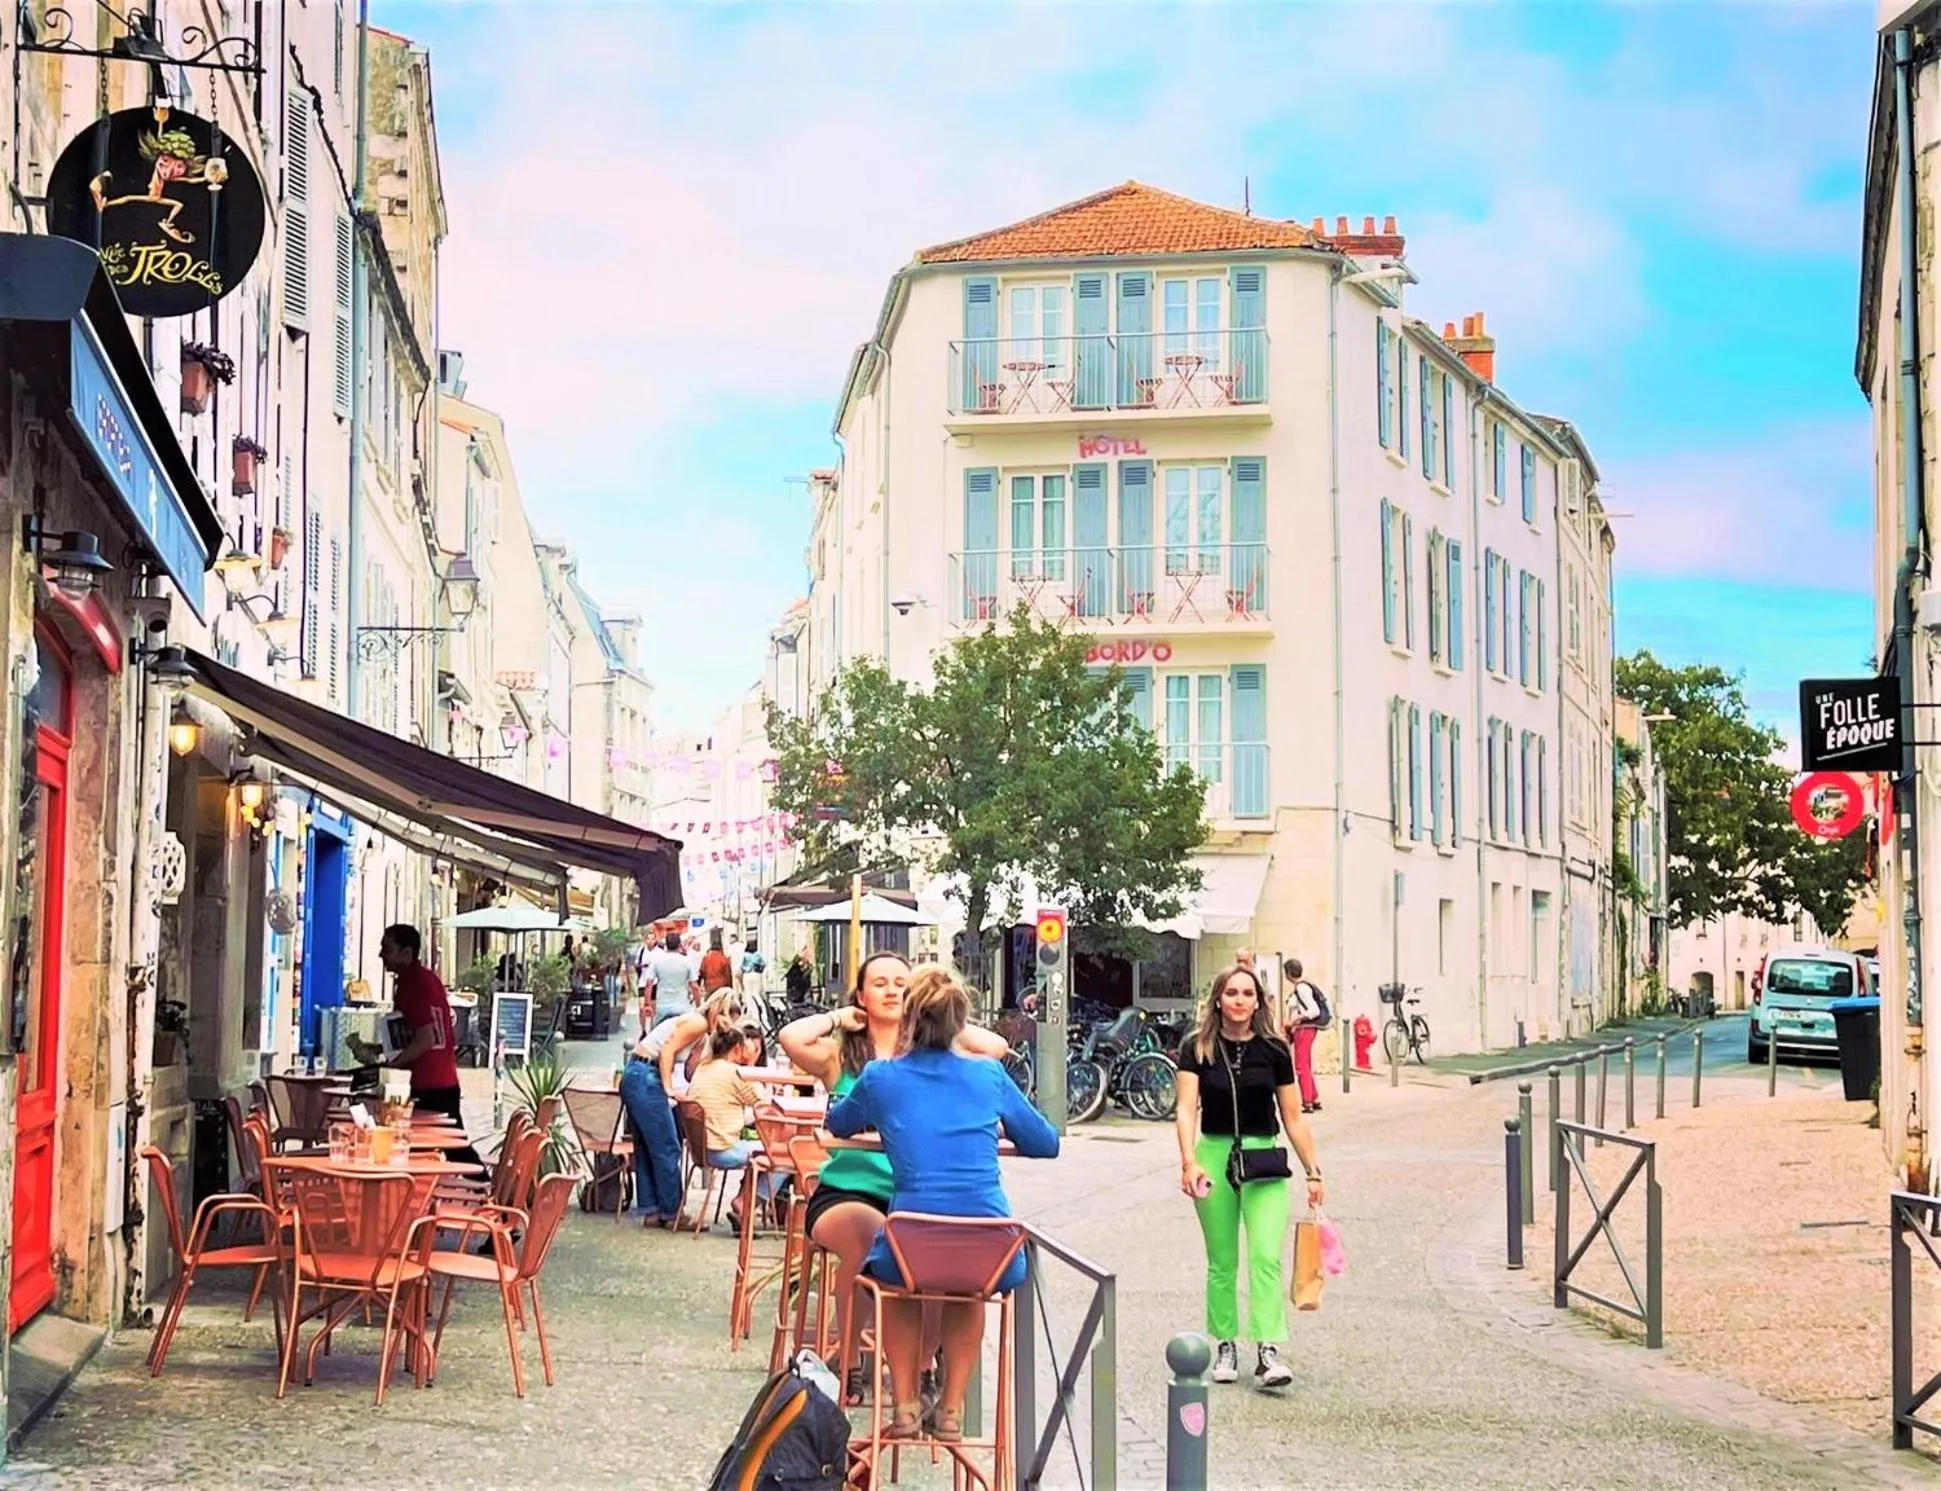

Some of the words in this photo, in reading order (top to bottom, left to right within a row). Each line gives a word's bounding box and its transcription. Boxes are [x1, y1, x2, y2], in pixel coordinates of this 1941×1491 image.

[115, 240, 223, 295] TROLLS
[1815, 692, 1834, 705] UNE
[1820, 693, 1881, 730] FOLLE
[1826, 718, 1895, 750] ÉPOQUE
